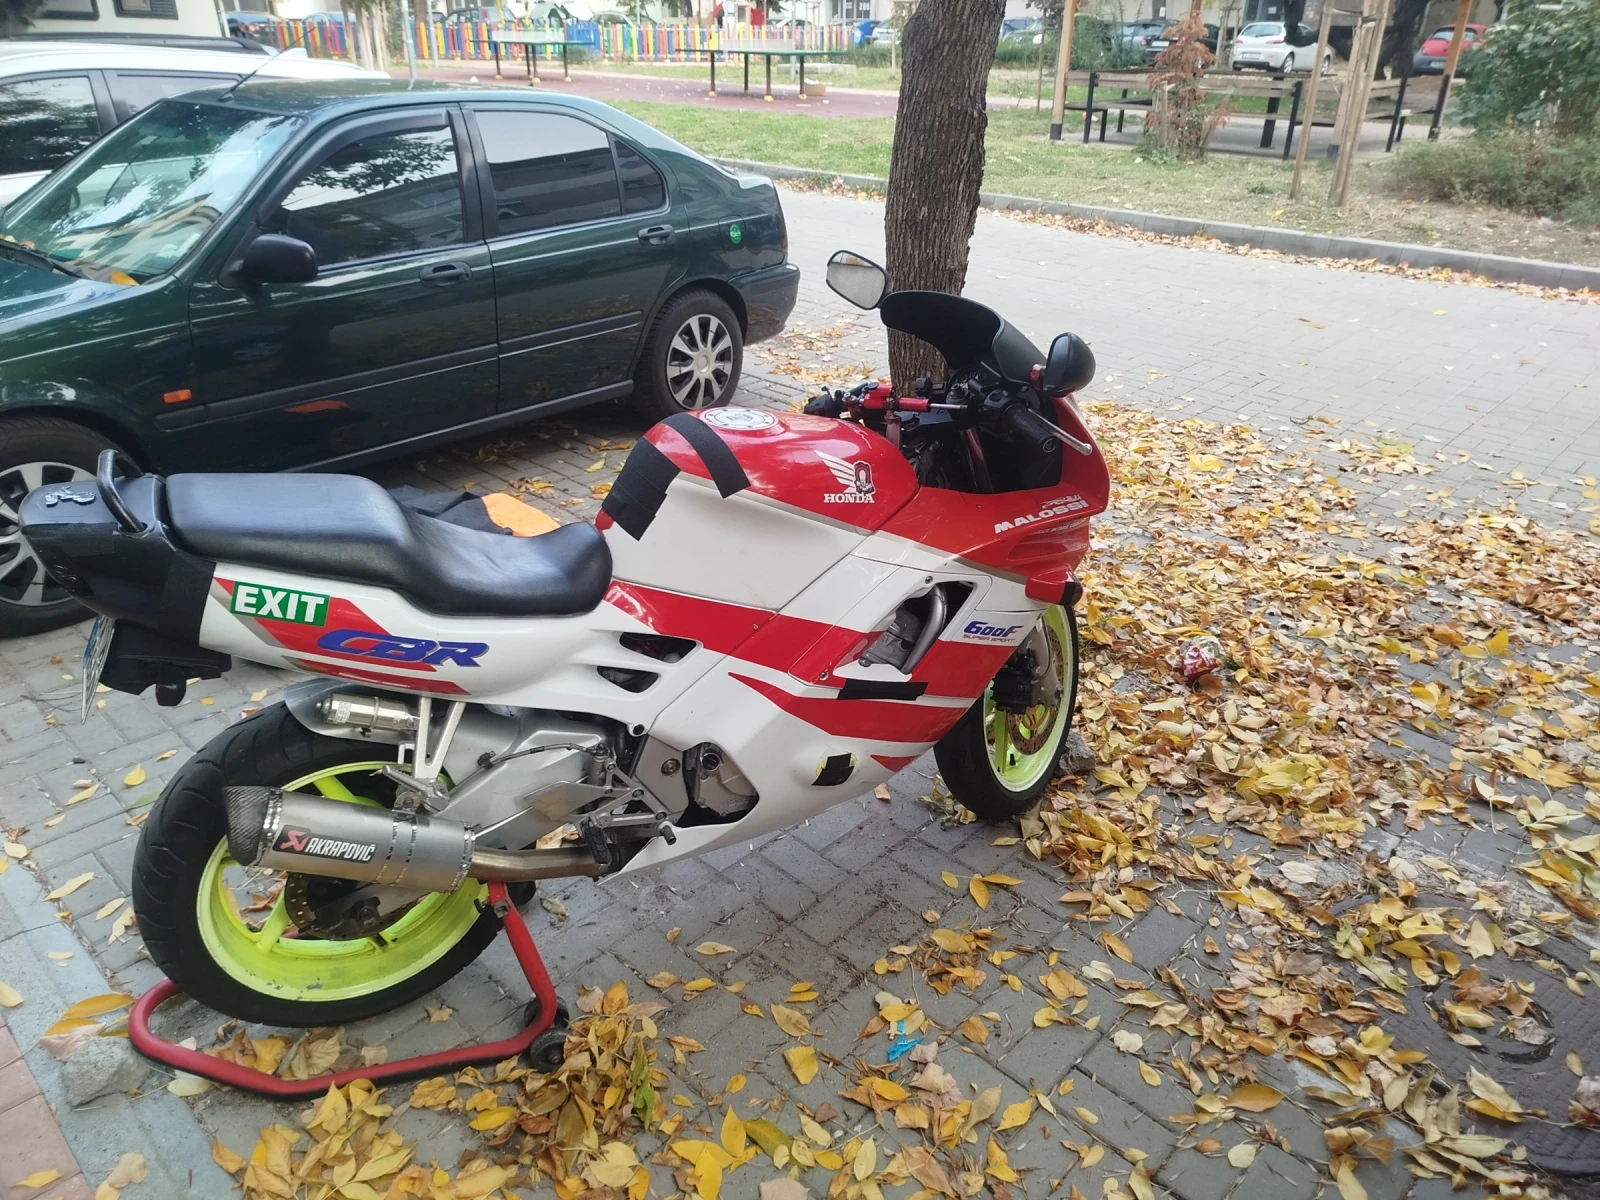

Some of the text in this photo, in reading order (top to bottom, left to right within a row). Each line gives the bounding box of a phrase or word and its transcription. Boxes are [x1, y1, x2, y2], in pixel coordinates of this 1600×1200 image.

[823, 493, 875, 503] HONDA
[993, 499, 1089, 534] MALOSSI
[234, 585, 325, 623] EXIT
[962, 633, 990, 641] SUPER
[963, 620, 1024, 637] 600F
[317, 629, 490, 667] CBR
